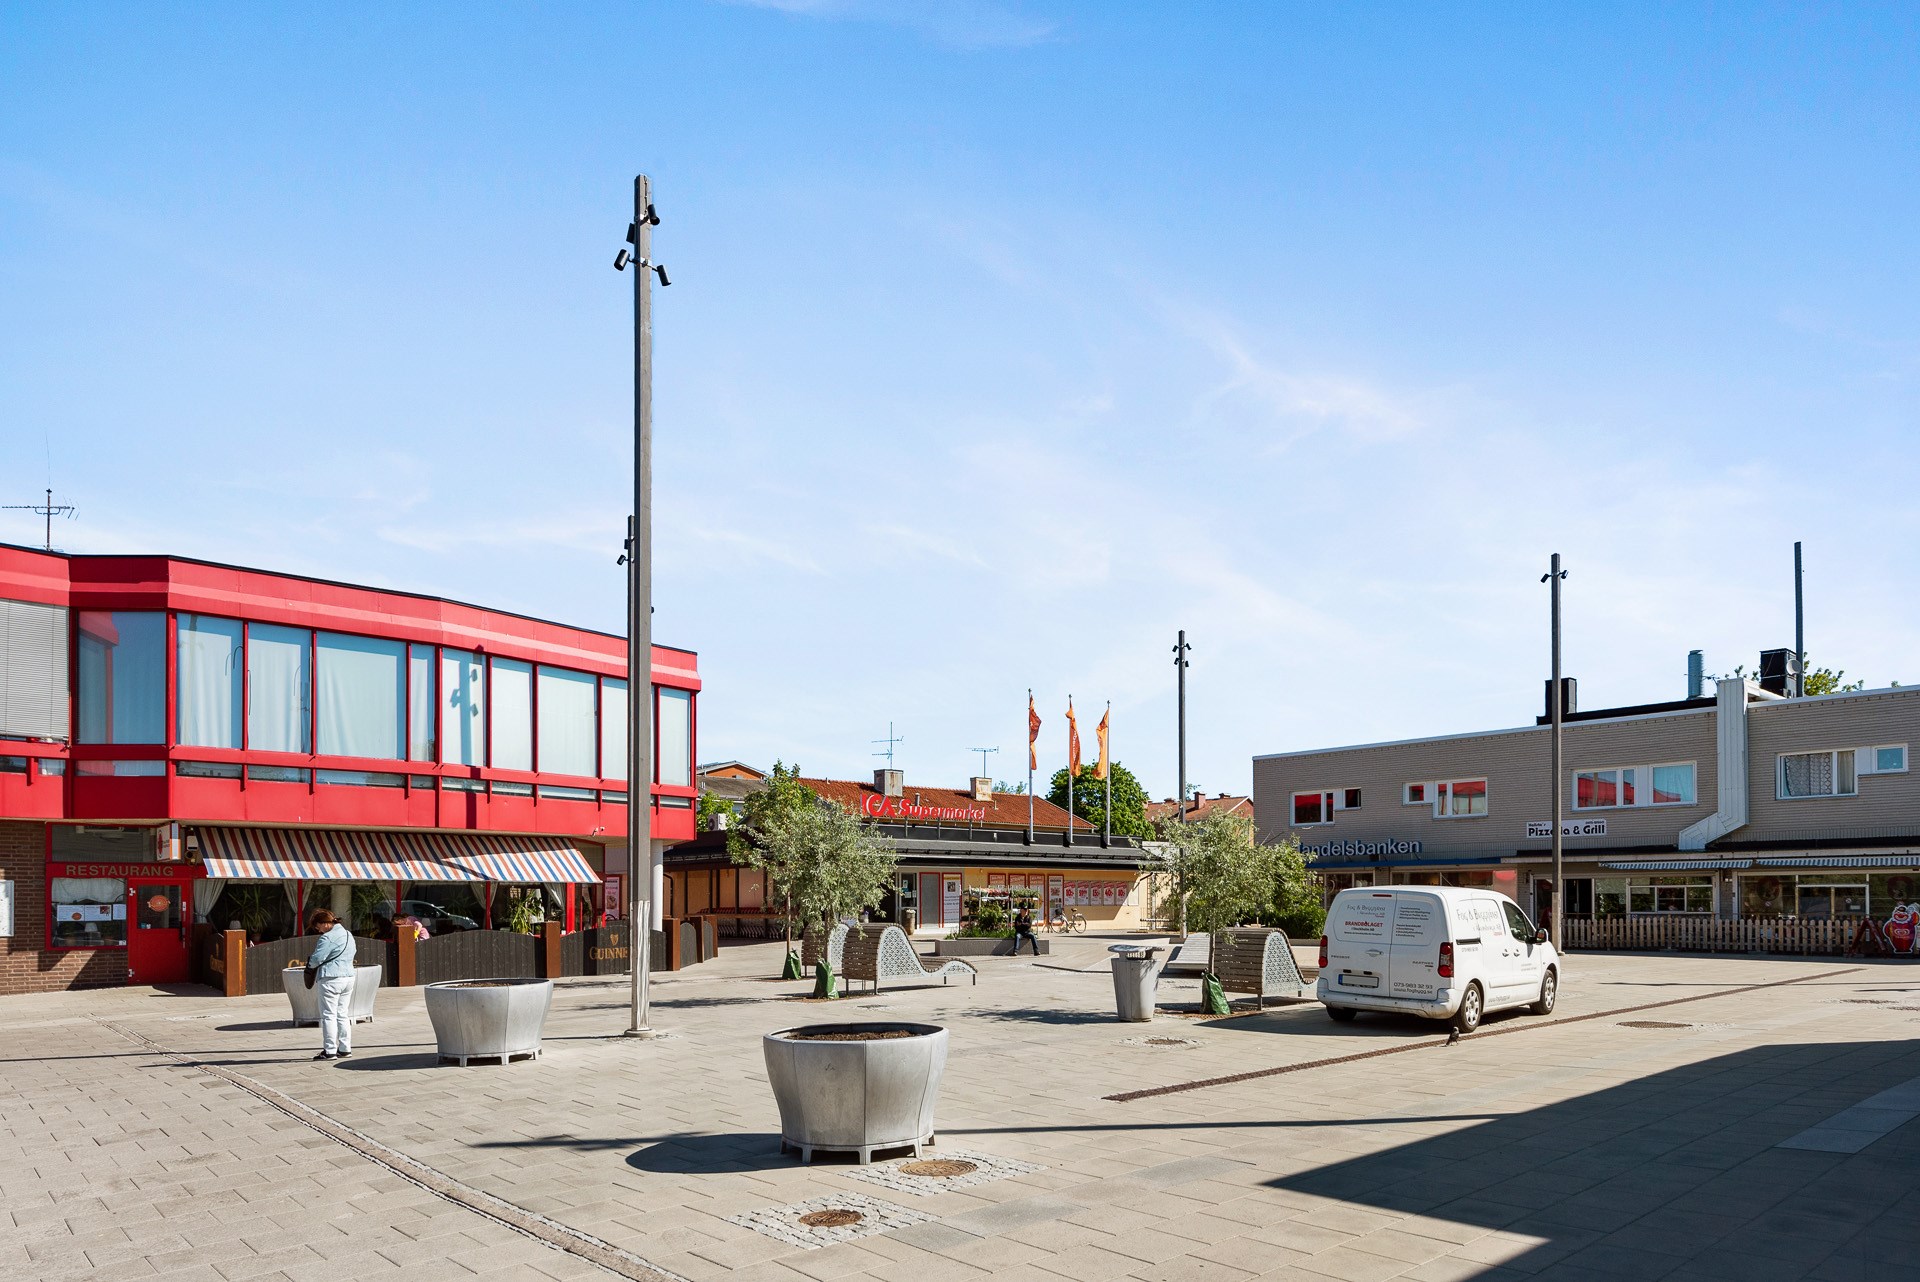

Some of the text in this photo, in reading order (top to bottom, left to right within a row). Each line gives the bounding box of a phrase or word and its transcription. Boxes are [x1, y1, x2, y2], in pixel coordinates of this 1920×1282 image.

[861, 793, 985, 820] ICA Supermarket
[1573, 826, 1580, 835] &
[1583, 825, 1605, 834] Grill
[66, 865, 174, 877] RESTAURANG
[590, 947, 628, 959] GUINNE
